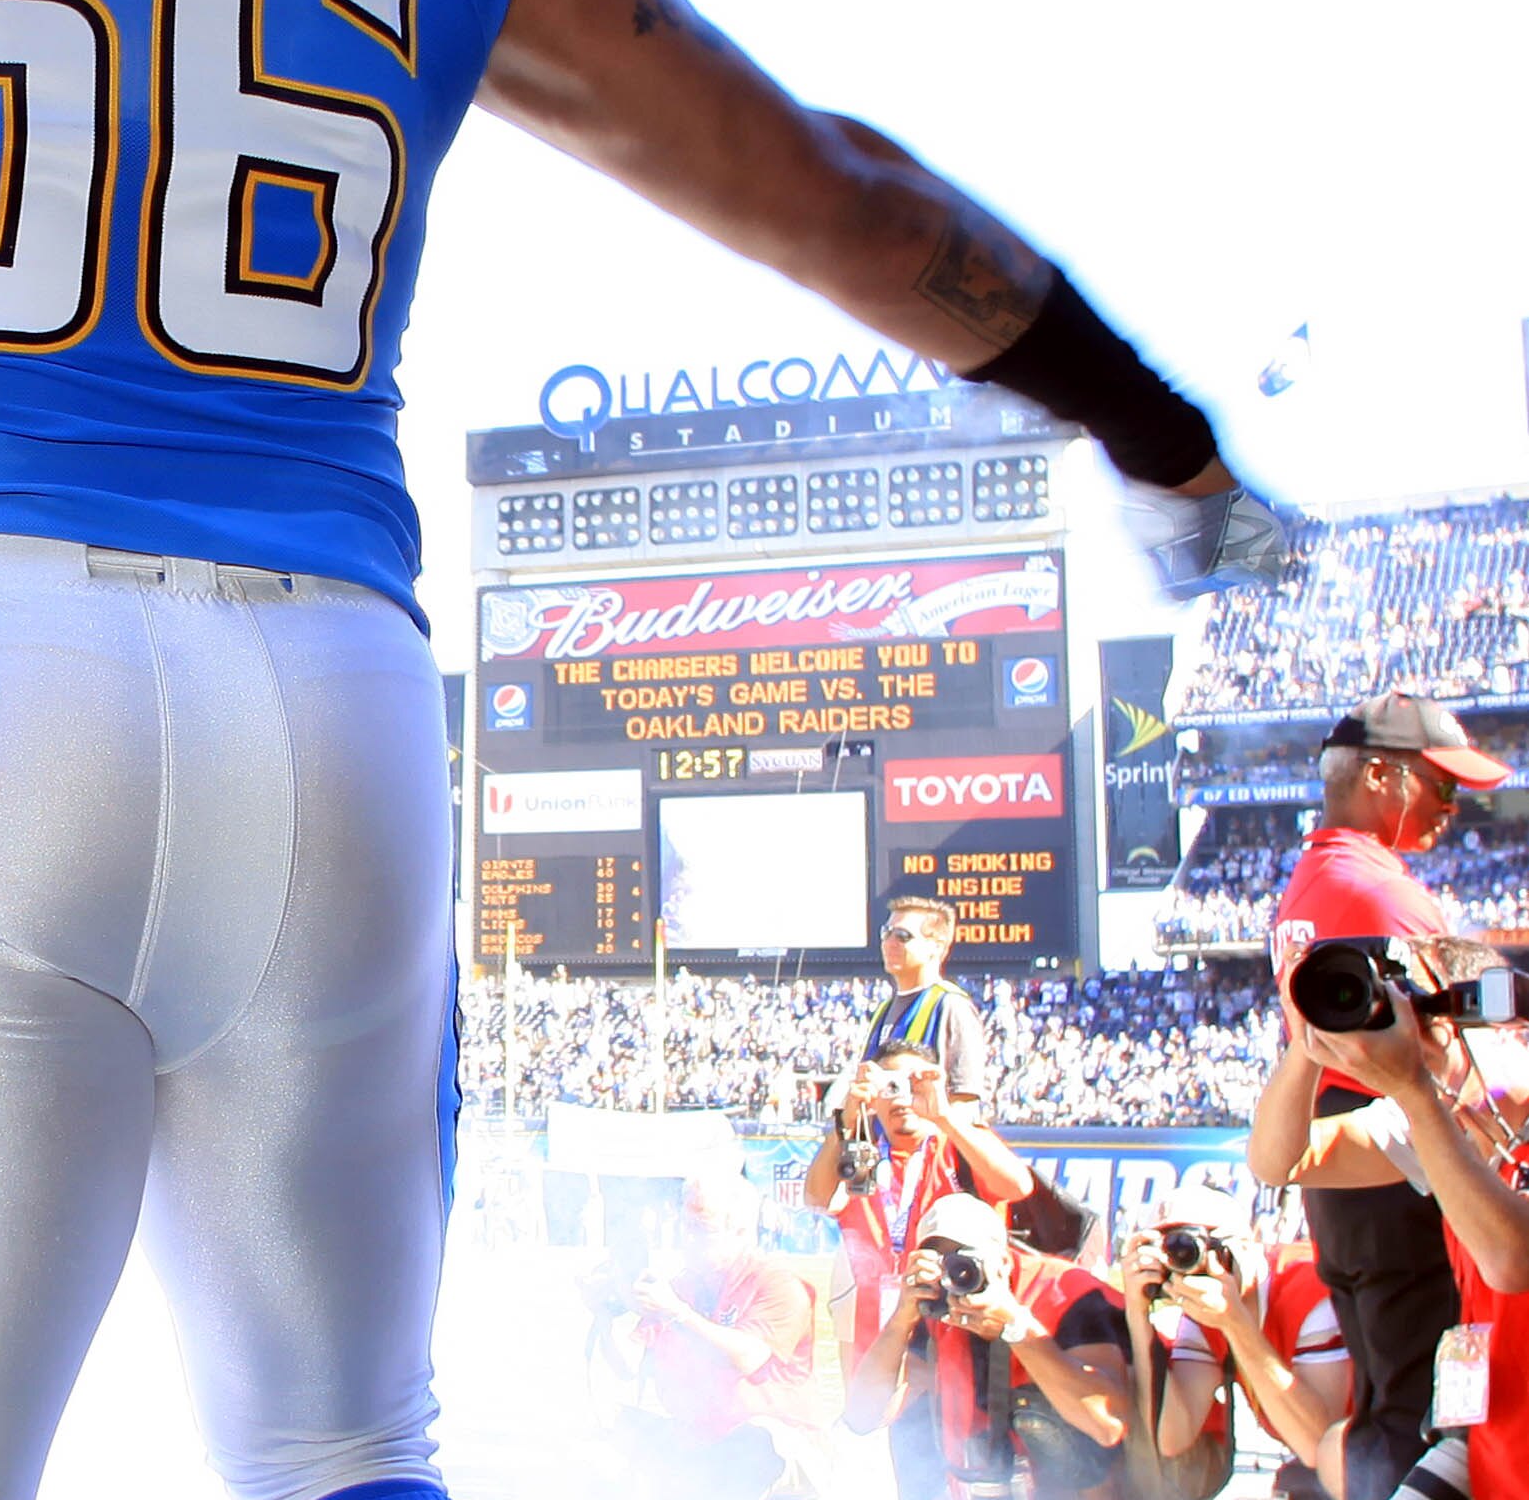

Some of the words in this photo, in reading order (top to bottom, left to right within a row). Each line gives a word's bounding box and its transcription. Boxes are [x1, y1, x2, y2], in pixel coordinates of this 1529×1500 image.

[629, 405, 952, 450] STADIUM
[528, 570, 914, 658] Budweiser
[554, 660, 602, 685] THE
[612, 653, 739, 682] CHARGERS
[749, 646, 864, 676] WELCOME
[877, 643, 930, 669] YOU
[942, 640, 979, 666] TO
[600, 683, 715, 711] TODAY'S
[729, 679, 808, 706] GAME
[820, 676, 864, 701] VS.
[877, 672, 936, 699] THE
[625, 710, 766, 741] OAKLAND
[778, 703, 914, 735] RAIDERS
[658, 748, 744, 780] 12:57
[892, 773, 1054, 807] TOYOTA
[903, 853, 938, 874] NO
[946, 851, 1055, 873] SMOKING
[936, 876, 1025, 897] INSIDE
[955, 900, 1002, 919] THE
[481, 919, 527, 930] LIOS
[954, 923, 1034, 944] ADIUM
[481, 933, 544, 944] BROCOS
[481, 944, 536, 955] RAVNS
